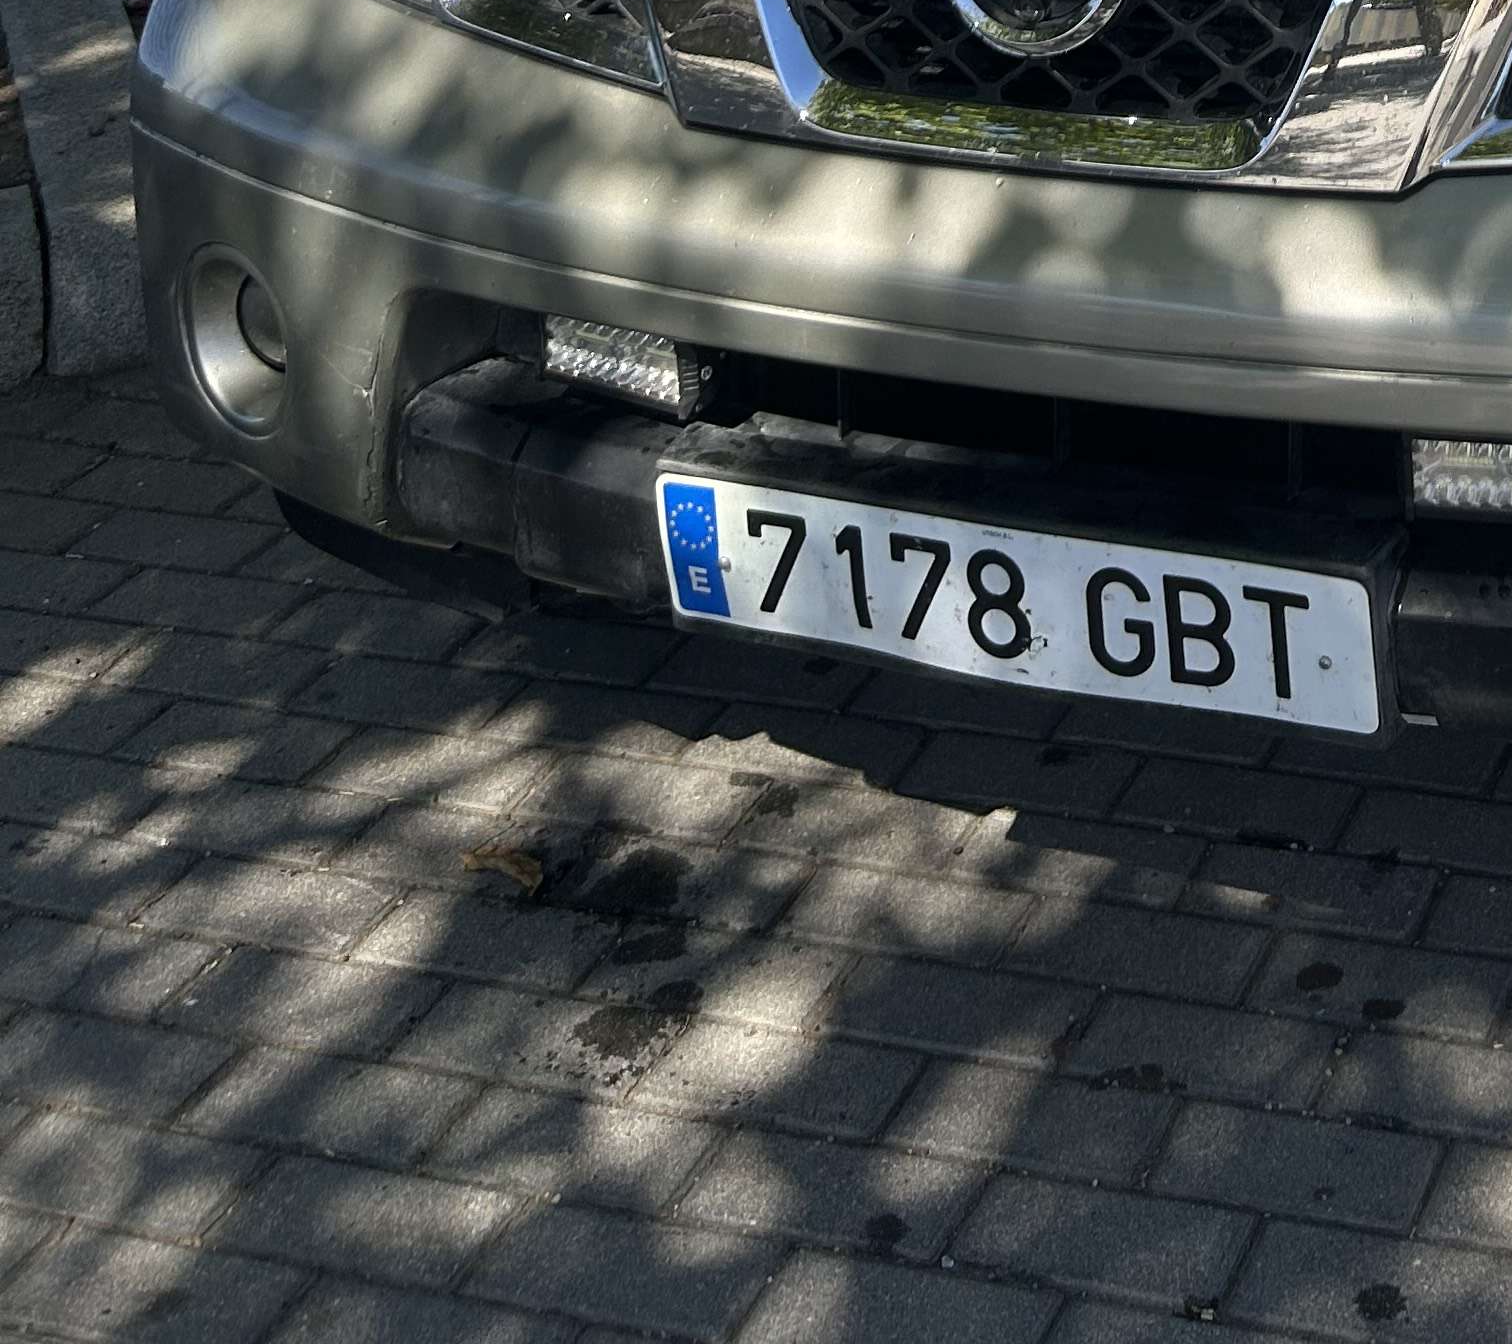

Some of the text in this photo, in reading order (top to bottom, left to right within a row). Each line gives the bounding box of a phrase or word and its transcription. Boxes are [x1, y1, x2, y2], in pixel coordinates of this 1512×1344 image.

[688, 566, 711, 594] E
[747, 508, 1310, 699] 7178 GBT
